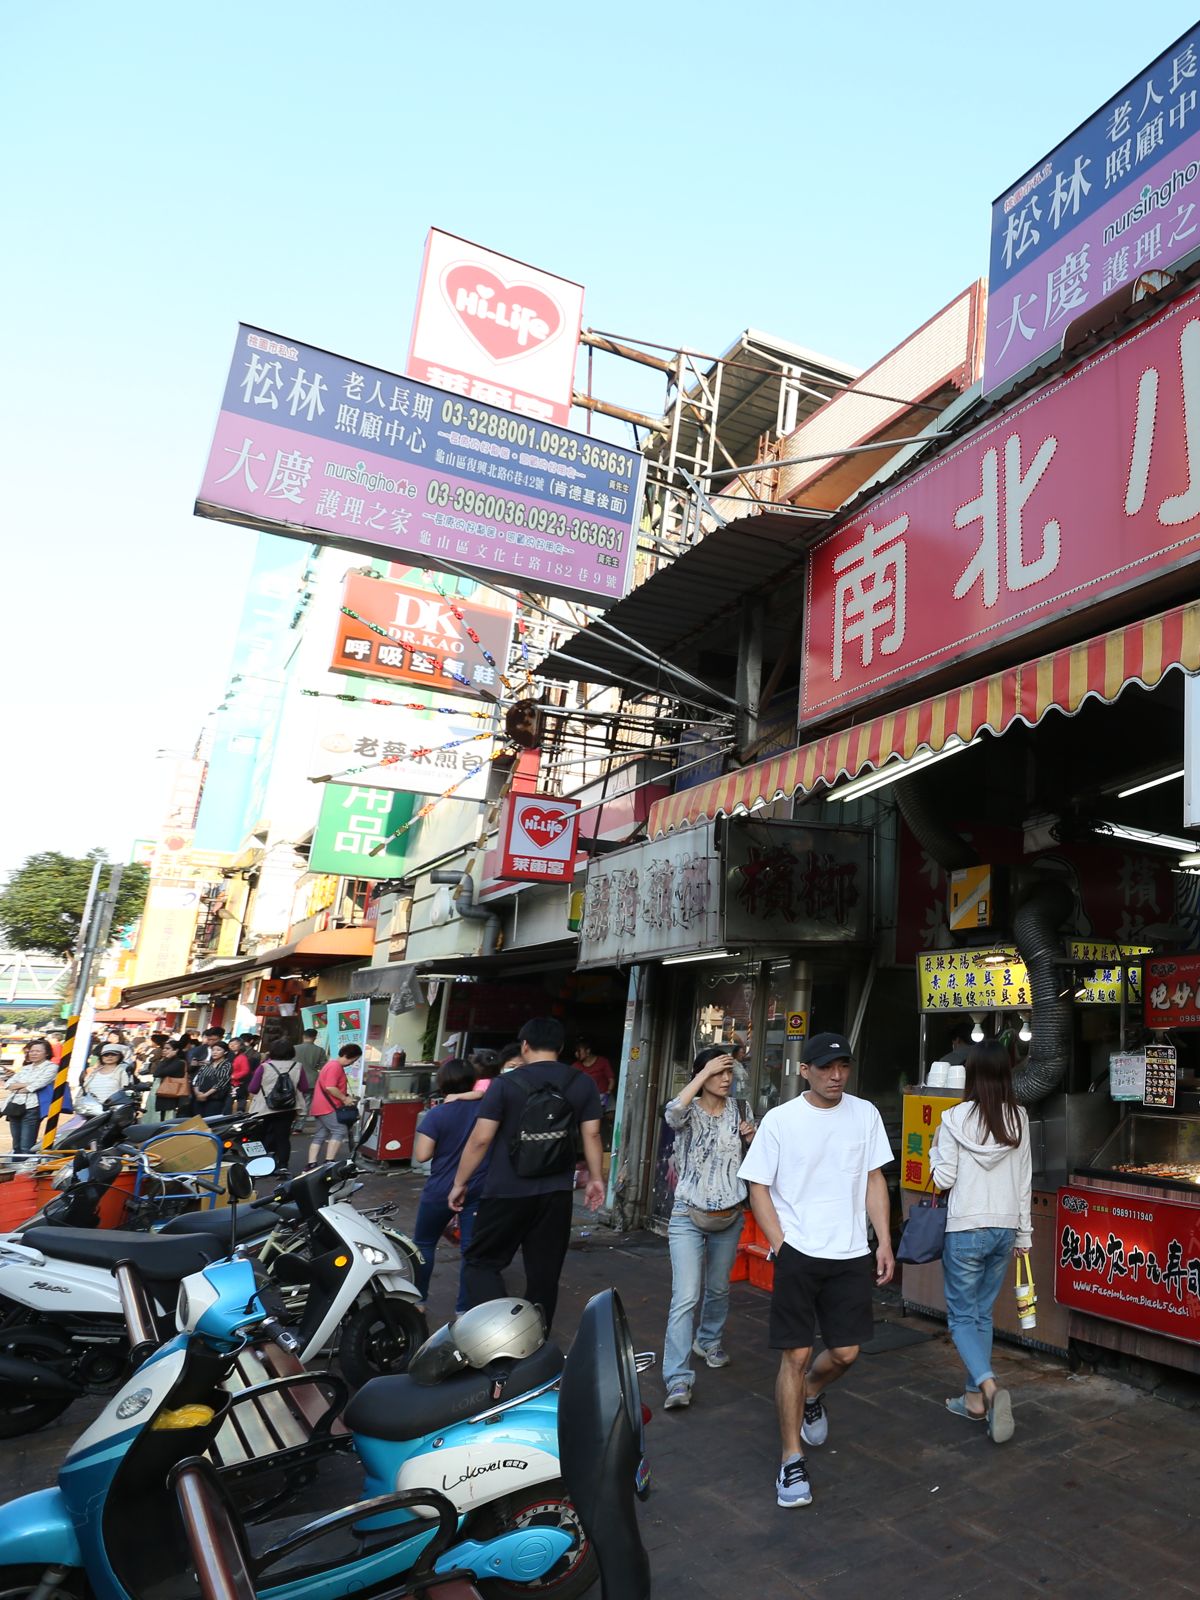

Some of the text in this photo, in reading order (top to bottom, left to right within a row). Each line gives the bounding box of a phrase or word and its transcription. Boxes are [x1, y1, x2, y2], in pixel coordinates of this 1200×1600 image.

[1001, 154, 1092, 270] 松林
[455, 283, 549, 346] Hi-Life
[994, 243, 1091, 367] 大慶
[239, 353, 328, 422] 松林
[342, 371, 434, 423] 老人長期
[334, 403, 427, 454] 照顧中心
[214, 438, 314, 504] 大慶
[314, 487, 413, 537] 護理之家
[389, 592, 467, 641] DK
[524, 815, 563, 838] Hi-Life
[512, 857, 565, 875] 萊爾富
[1112, 1206, 1154, 1222] 0989111940
